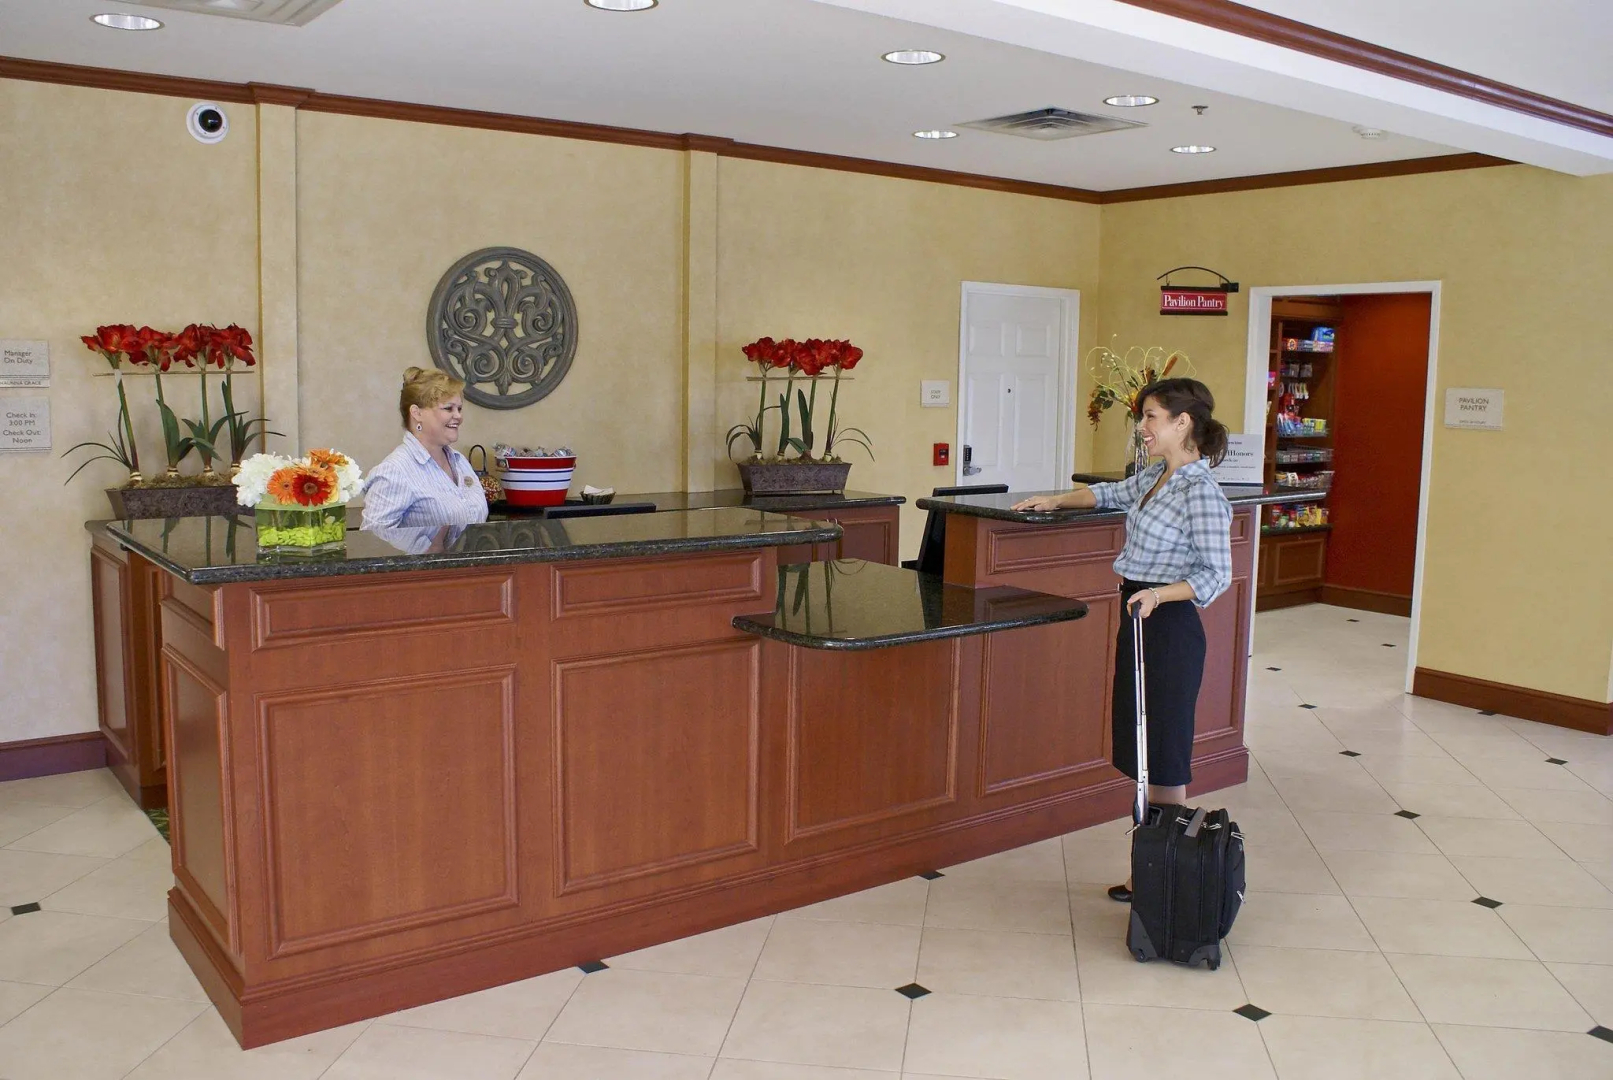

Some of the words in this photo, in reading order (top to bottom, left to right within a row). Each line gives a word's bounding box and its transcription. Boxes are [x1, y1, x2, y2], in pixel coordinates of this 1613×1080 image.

[1164, 294, 1196, 307] Pavilion
[1197, 295, 1224, 309] Pantry
[4, 350, 32, 358] Manager
[17, 357, 33, 365] Duty
[1458, 397, 1489, 405] PAVILION
